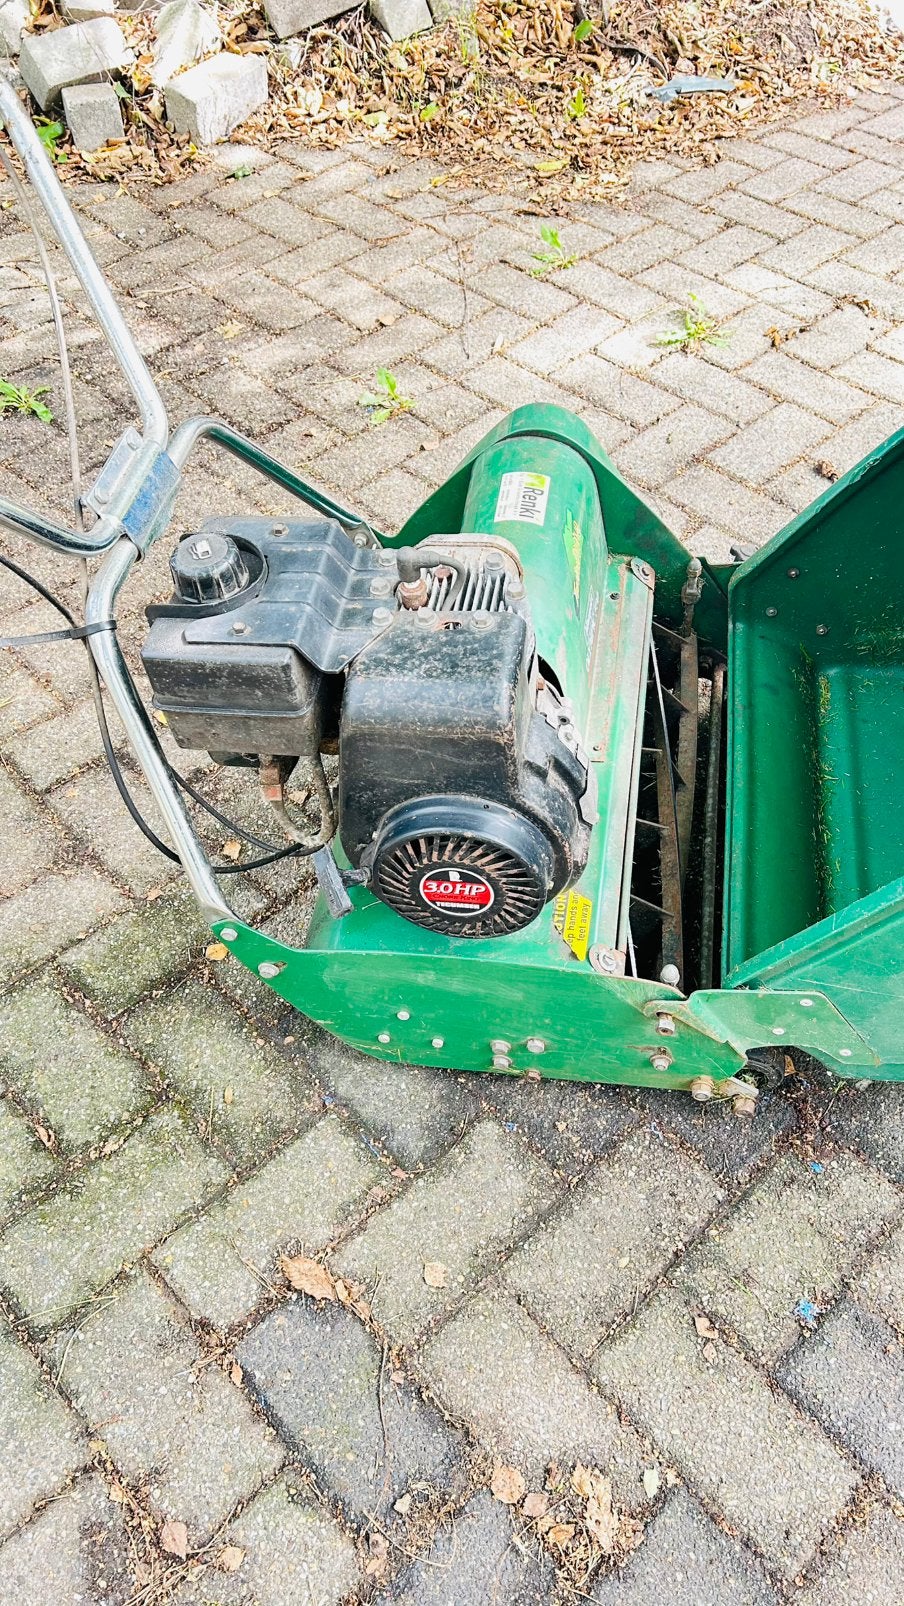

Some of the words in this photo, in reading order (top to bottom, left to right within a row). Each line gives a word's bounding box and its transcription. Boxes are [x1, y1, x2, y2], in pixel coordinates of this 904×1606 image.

[567, 906, 578, 931] hands
[580, 902, 591, 924] away
[566, 933, 575, 948] ep
[576, 926, 586, 942] feet
